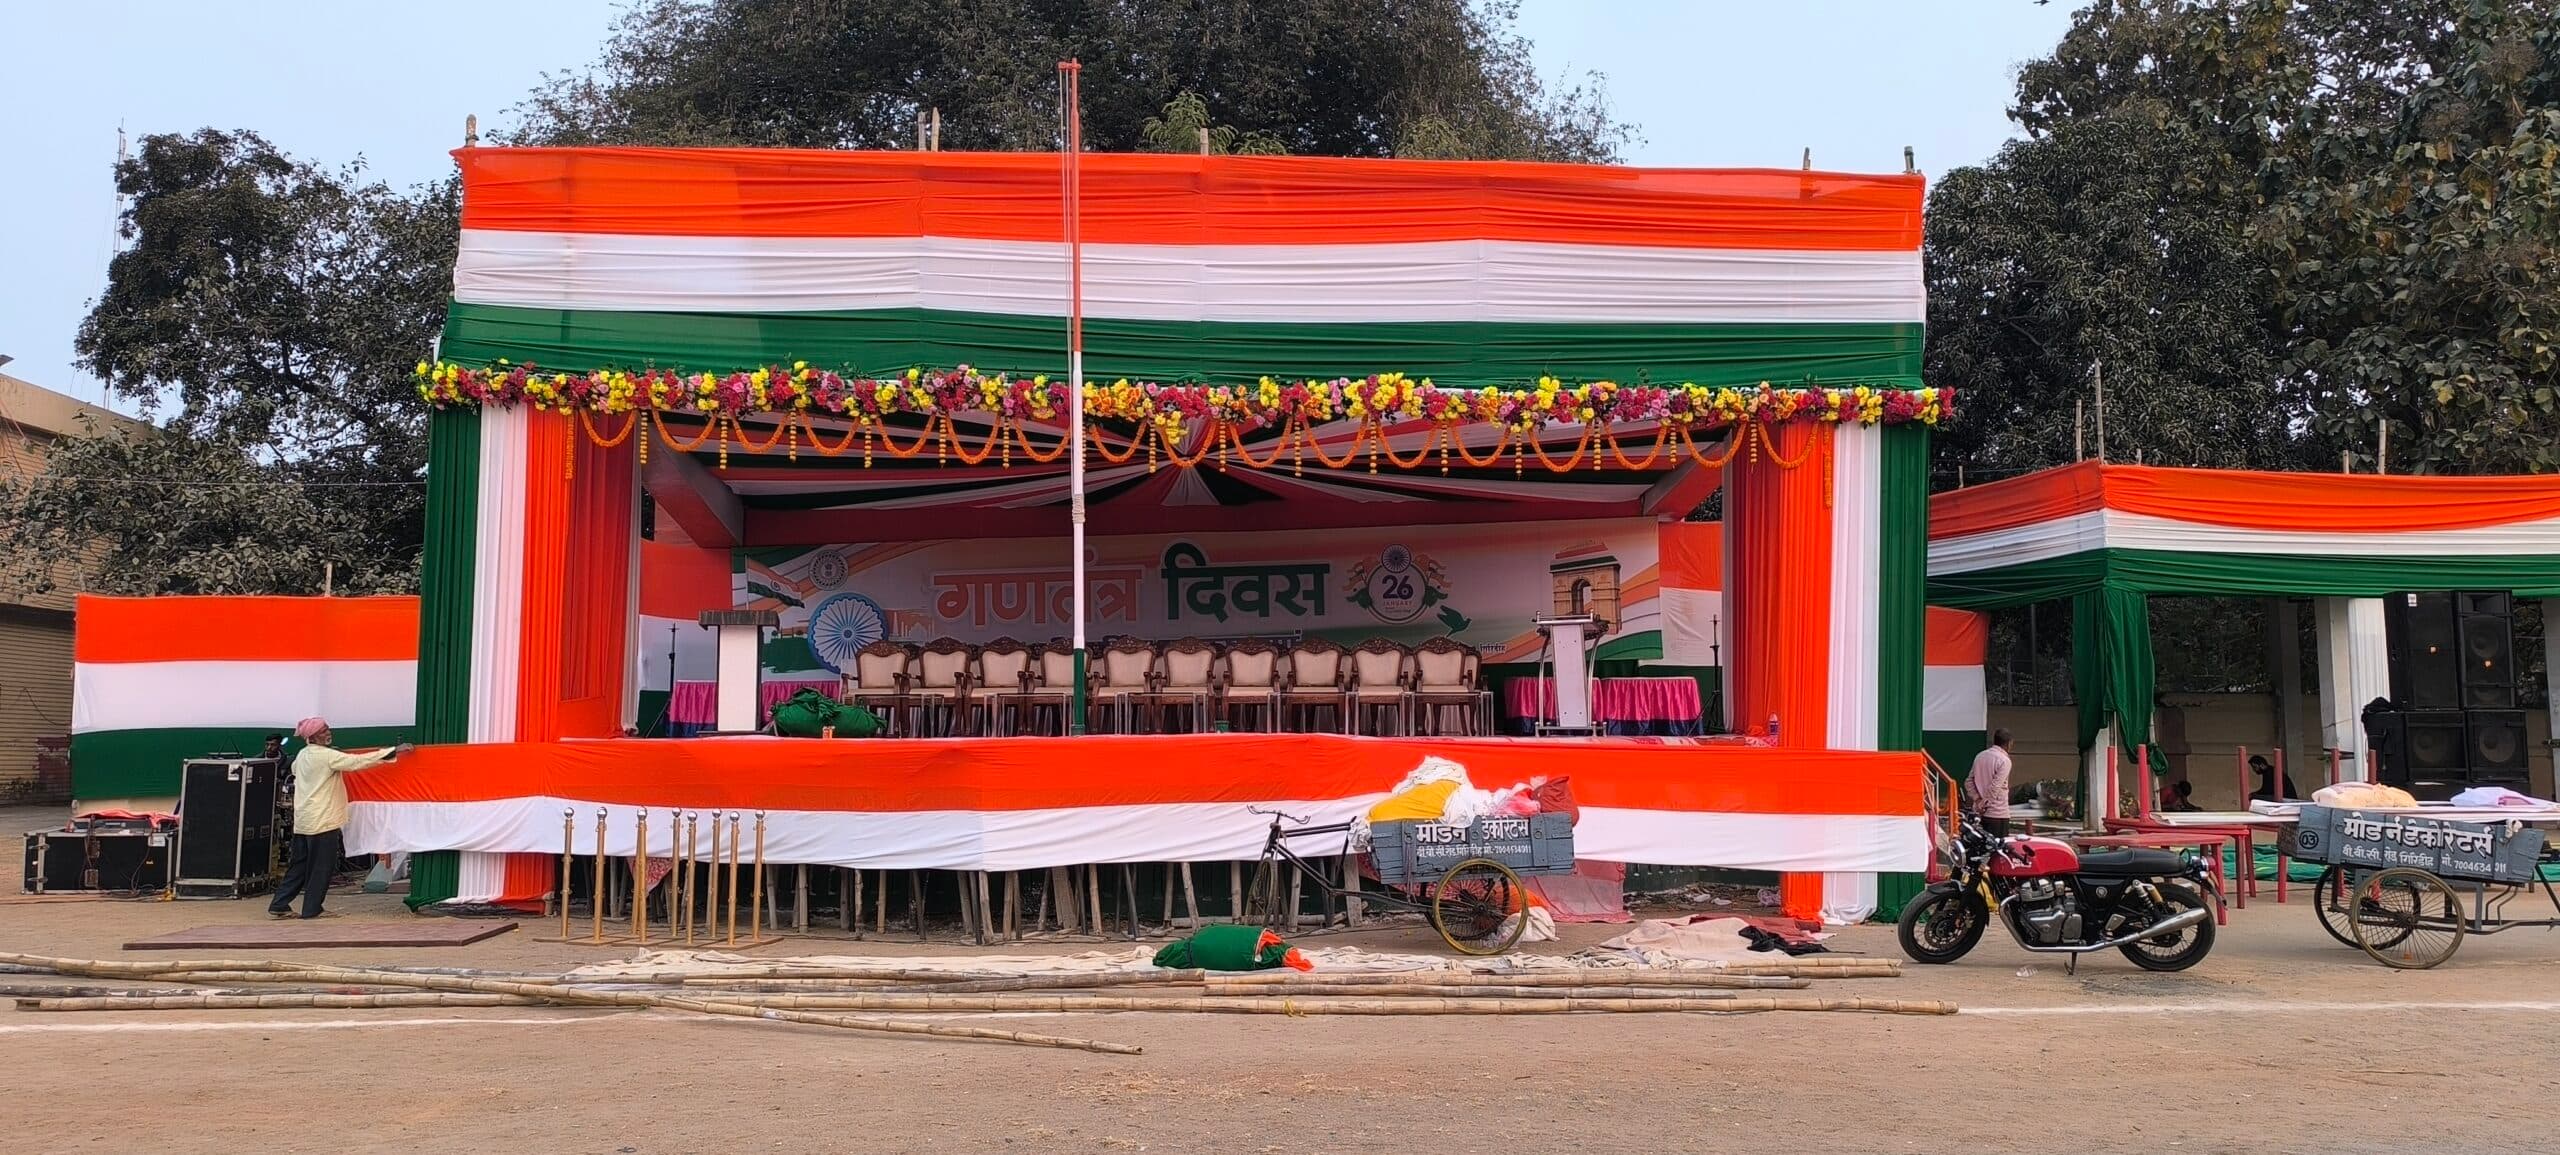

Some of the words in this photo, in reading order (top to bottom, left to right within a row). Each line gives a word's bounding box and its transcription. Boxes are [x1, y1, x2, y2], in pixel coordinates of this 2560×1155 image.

[933, 548, 1143, 627] गणतंत्र
[1161, 542, 1330, 623] दिवस
[1382, 574, 1414, 600] 26
[2301, 834, 2316, 846] 03
